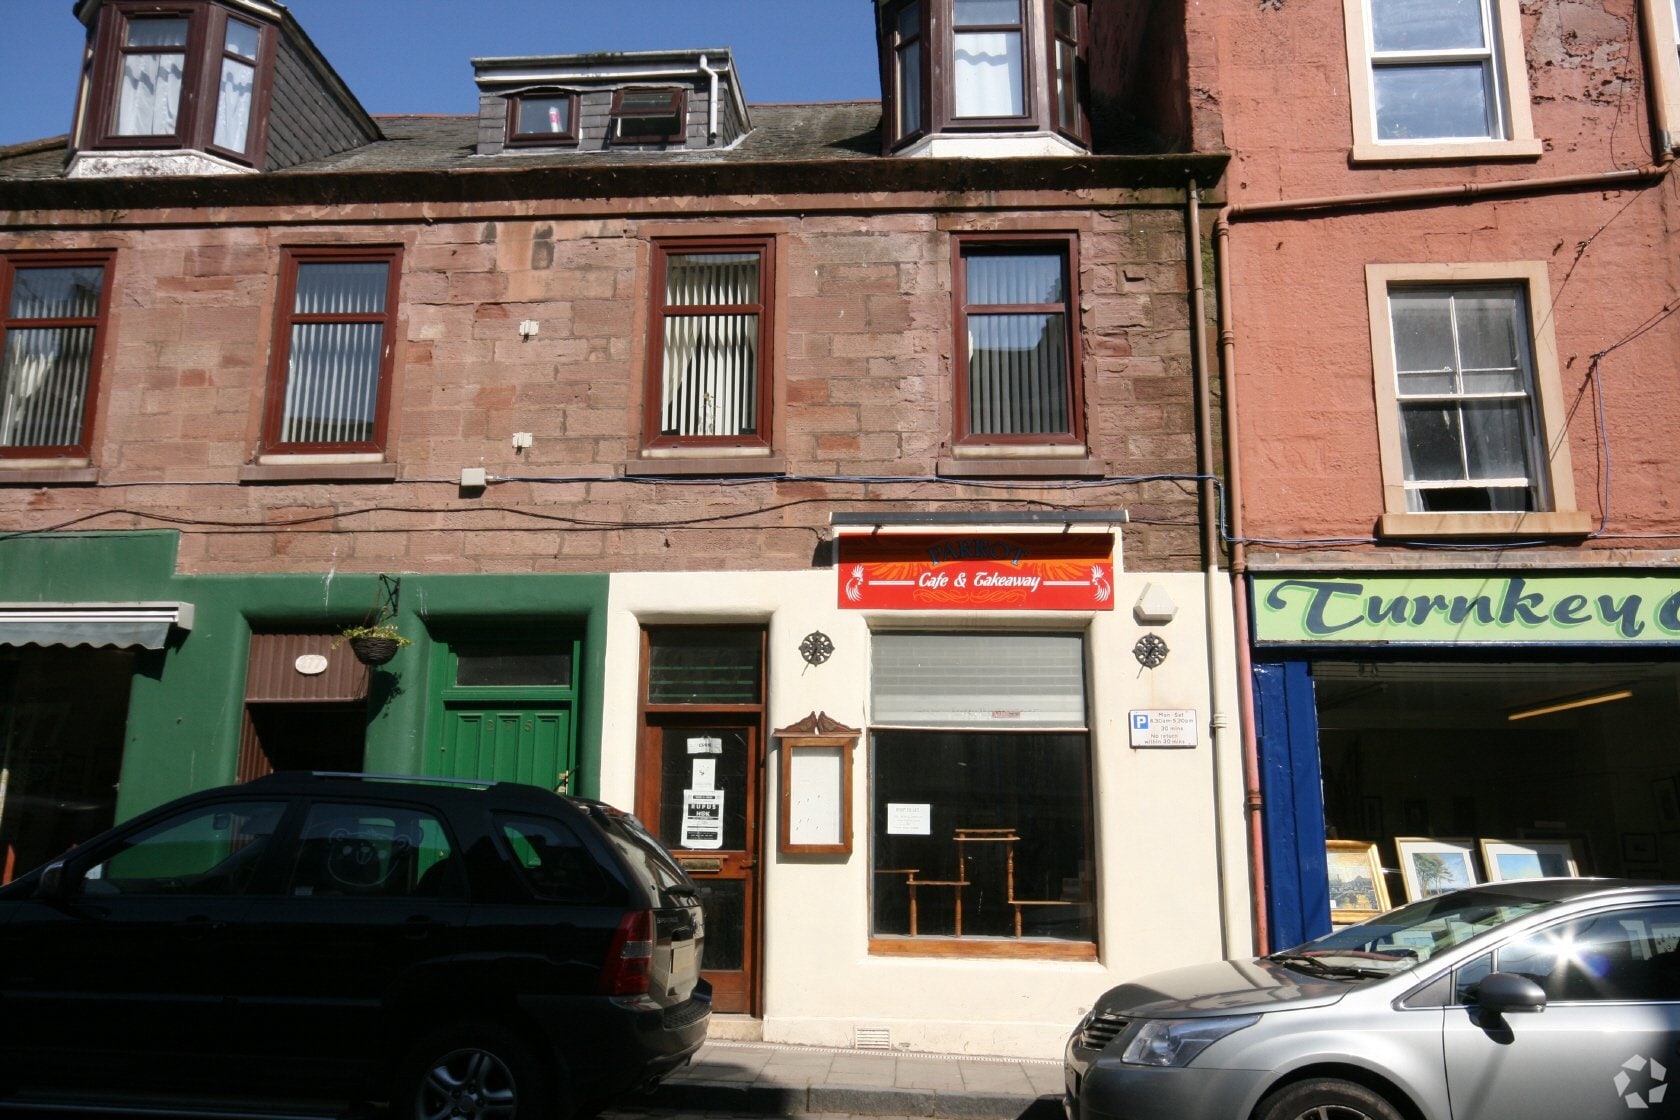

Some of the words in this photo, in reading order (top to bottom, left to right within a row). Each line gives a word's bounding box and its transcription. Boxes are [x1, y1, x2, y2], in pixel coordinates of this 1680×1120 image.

[927, 540, 1030, 566] PARROT
[918, 571, 949, 589] Cafe
[953, 572, 967, 588] &
[973, 571, 1041, 592] Takeaway
[1266, 577, 1645, 638] Turnkey
